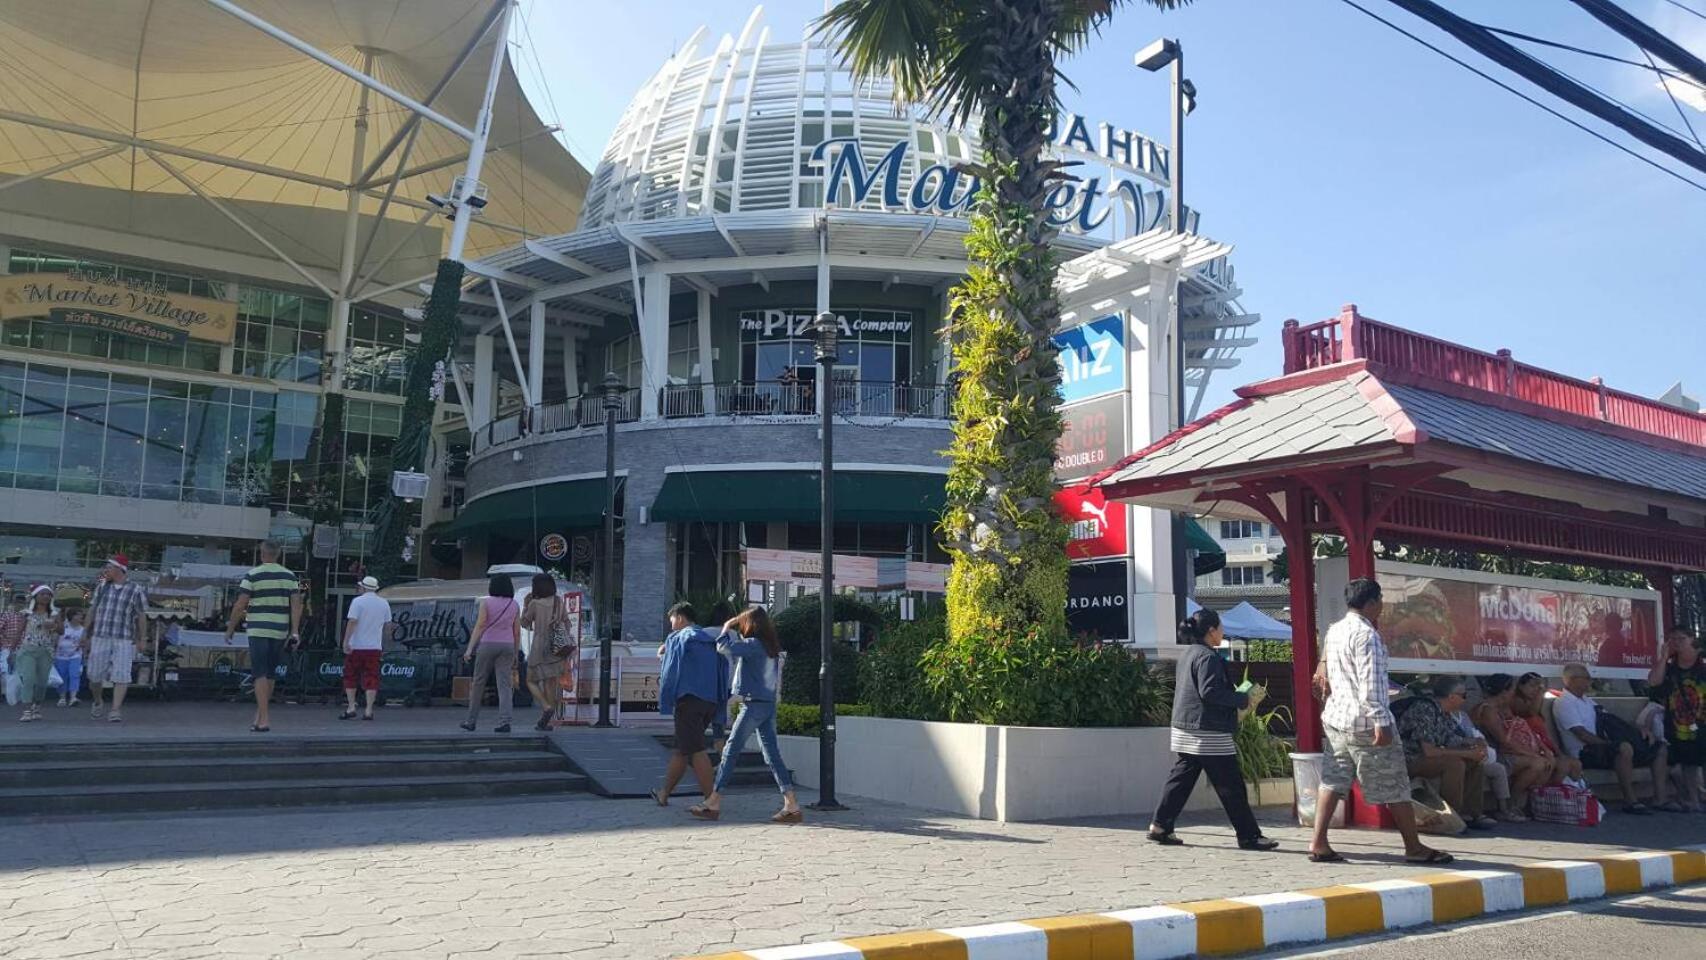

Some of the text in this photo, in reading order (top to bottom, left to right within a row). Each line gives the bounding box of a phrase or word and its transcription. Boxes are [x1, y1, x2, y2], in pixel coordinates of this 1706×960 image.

[1099, 121, 1171, 181] HIN
[808, 136, 1112, 234] Maet
[24, 282, 209, 327] Market Village
[740, 309, 912, 336] The PIZA Company
[1069, 519, 1099, 540] UMA
[1061, 594, 1125, 609] ORDANO
[381, 662, 415, 678] Chang
